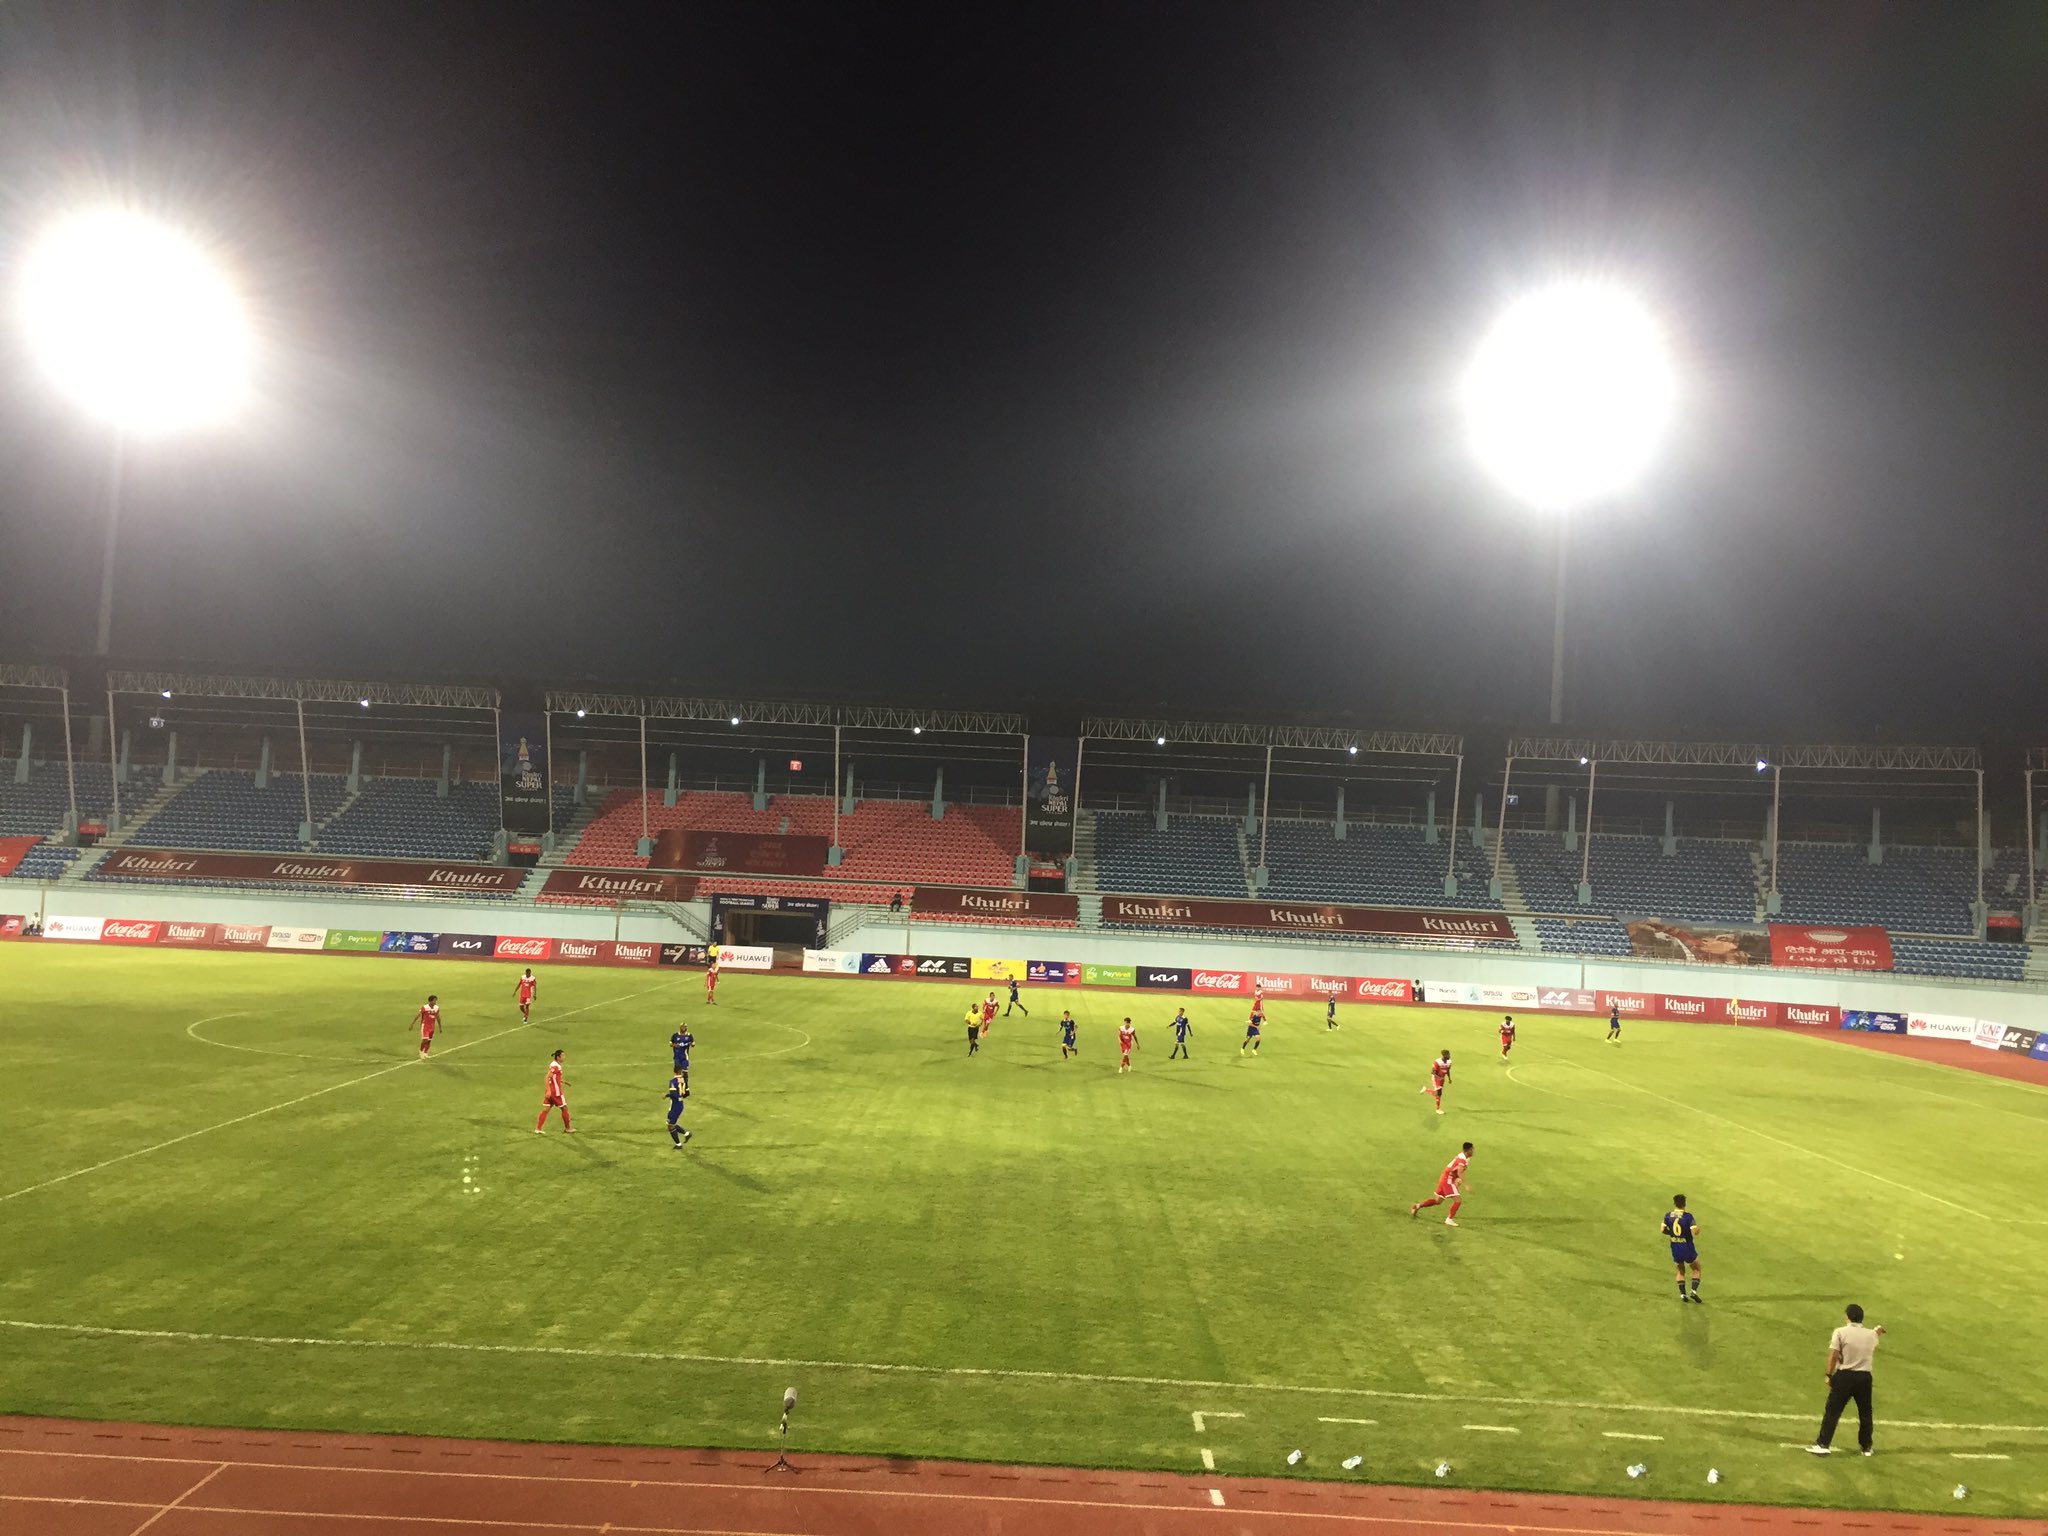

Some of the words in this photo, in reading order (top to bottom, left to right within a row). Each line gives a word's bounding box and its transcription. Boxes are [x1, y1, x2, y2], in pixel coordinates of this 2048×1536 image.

[515, 780, 542, 789] SUPER
[1041, 804, 1068, 812] SUPER
[118, 855, 198, 870] Khukri
[272, 862, 351, 877] Khukri
[428, 870, 504, 884] Khukri
[578, 875, 664, 892] Khukri
[961, 894, 1030, 909] Khukri
[1118, 902, 1192, 917] Khukri
[1270, 909, 1344, 924] Khukri
[104, 922, 156, 939] Coca-Cola
[168, 924, 206, 938] Khukri
[1422, 917, 1498, 932] Khukri
[224, 928, 262, 941] Khukri
[498, 939, 548, 956] Coca-Cola
[560, 942, 597, 956] Khukri
[615, 944, 652, 957] Khukri
[868, 966, 891, 974] adidas
[1103, 970, 1131, 978] PayWell
[1194, 972, 1242, 990] Coca-Cola
[1256, 976, 1292, 990] Khukri
[1311, 978, 1348, 992] Khukri
[1359, 980, 1407, 997] Coca-Cola
[1606, 994, 1645, 1008] Khukri
[1665, 998, 1705, 1012] Khukri
[1726, 1003, 1767, 1018] Khukri
[1788, 1007, 1830, 1022] Khukri
[1930, 1024, 1971, 1034] HUAWEI
[1673, 1218, 1682, 1236] 6
